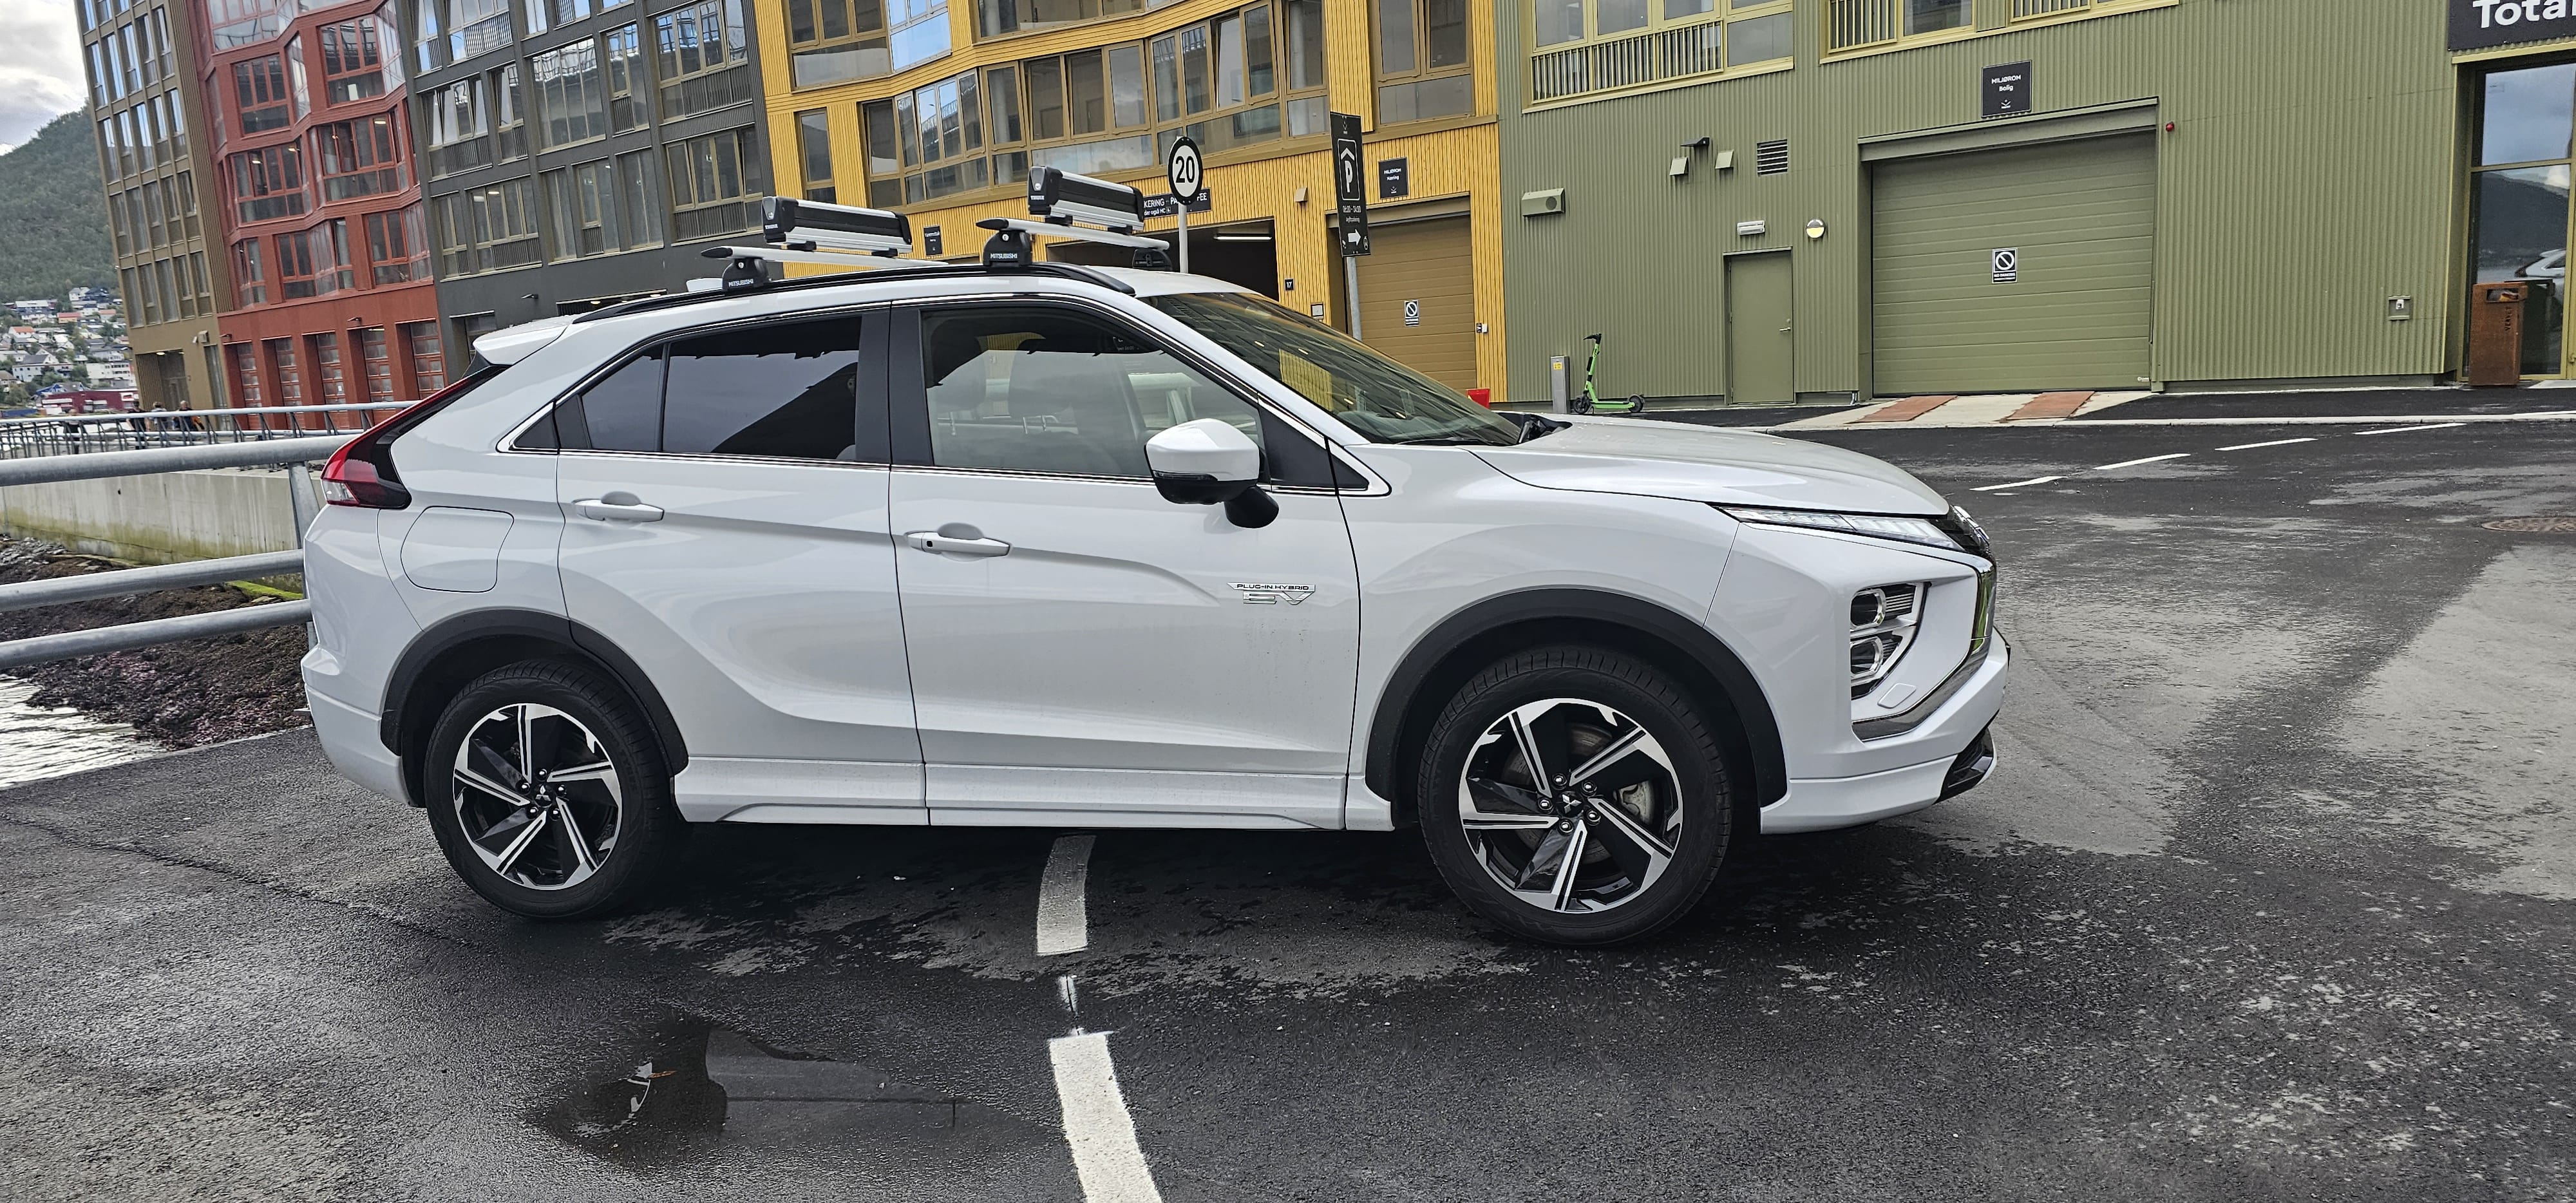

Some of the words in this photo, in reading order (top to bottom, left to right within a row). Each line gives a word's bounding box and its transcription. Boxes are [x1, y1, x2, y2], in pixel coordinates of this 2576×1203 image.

[1991, 74, 2021, 84] MILJØROM
[1175, 156, 1195, 183] 20
[1344, 160, 1353, 193] P
[728, 278, 754, 287] MITSUBISHI
[1243, 591, 1314, 605] EV
